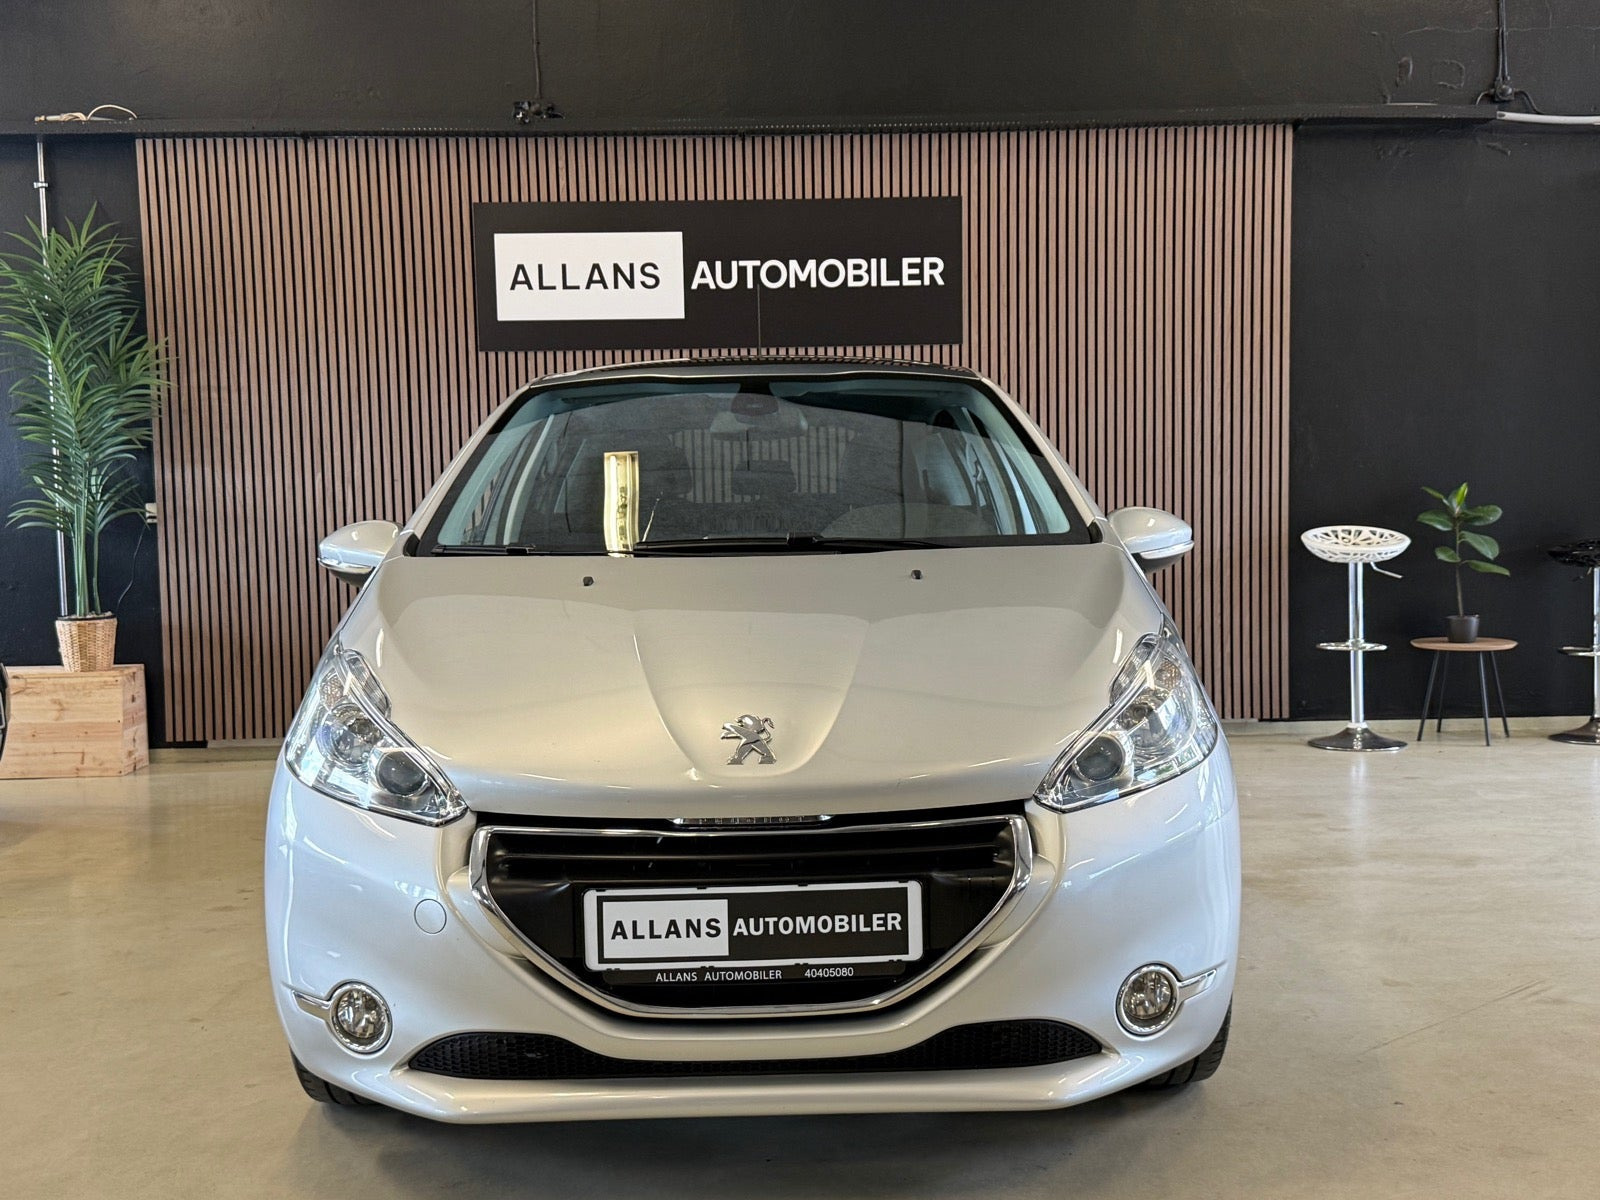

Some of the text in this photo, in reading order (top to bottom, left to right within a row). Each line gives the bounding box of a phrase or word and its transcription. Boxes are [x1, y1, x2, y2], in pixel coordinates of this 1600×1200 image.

[509, 256, 945, 291] ALLANS AUTOMOBILER
[610, 912, 902, 940] ALLANS AUTOMOBILER
[655, 966, 854, 983] ALLANS AUTOMOBILER 40405080
